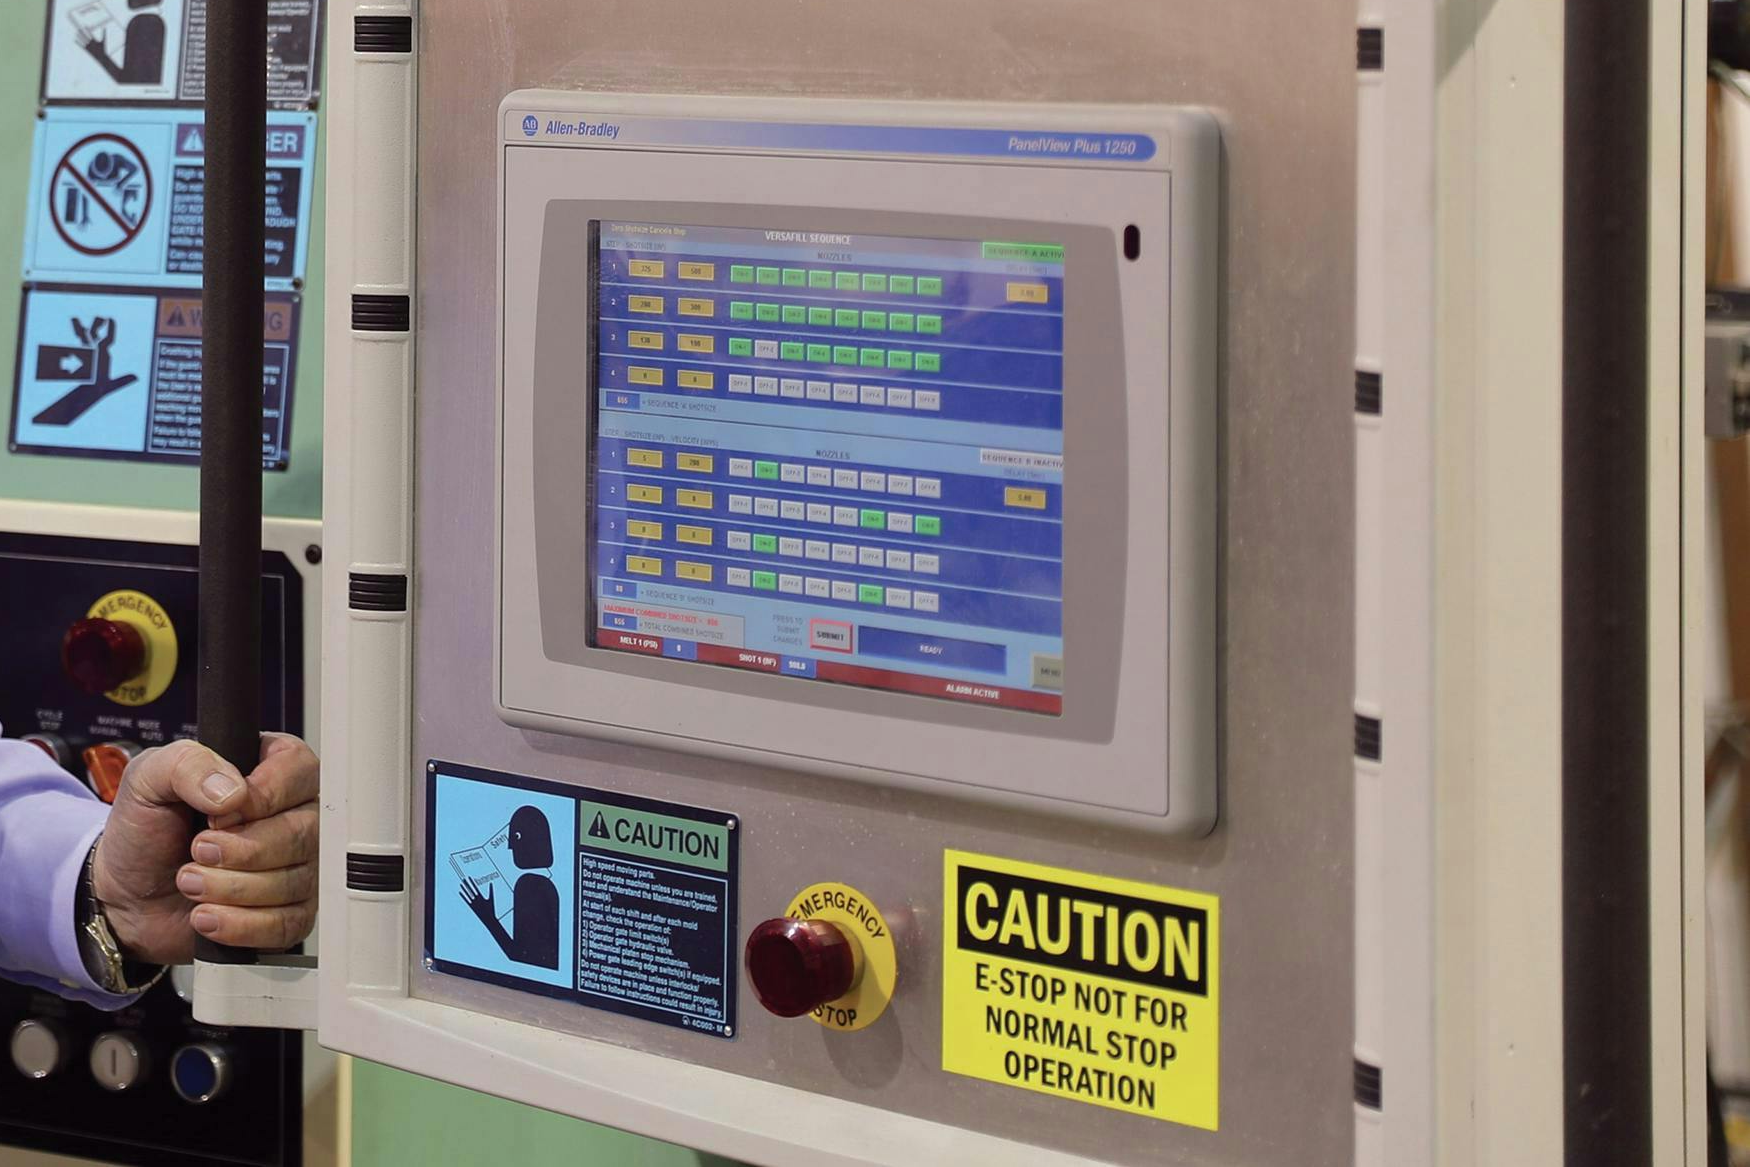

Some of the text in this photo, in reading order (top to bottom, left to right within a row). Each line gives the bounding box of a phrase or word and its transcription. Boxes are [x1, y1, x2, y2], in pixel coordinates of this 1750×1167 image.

[546, 120, 620, 140] Allen-Bradley
[1008, 137, 1137, 155] PanelView Plus 1250
[765, 230, 851, 245] VERSAFILL SEQUENCE
[817, 251, 852, 262] NOZZLES
[815, 449, 851, 460] NOZZLES
[93, 595, 168, 630] MERGENCY
[619, 635, 637, 646] MELT
[816, 630, 844, 642] SUBMIT
[738, 652, 756, 663] SHOT
[919, 644, 943, 656] READY
[946, 683, 1000, 700] ALARM ACTIVE
[614, 817, 720, 860] CAUTION
[583, 857, 596, 869] High
[597, 860, 614, 873] speed
[616, 864, 637, 877] moving
[583, 878, 595, 888] read
[596, 881, 607, 891] and
[608, 883, 641, 897] understand
[642, 890, 651, 899] the
[592, 871, 601, 880] not
[602, 873, 624, 886] operate
[625, 877, 649, 889] machine
[651, 882, 670, 893] unless
[671, 887, 682, 898] you
[684, 890, 693, 898] are
[590, 900, 603, 911] start
[611, 905, 625, 915] each
[626, 908, 639, 918] shift
[640, 911, 651, 921] and
[652, 913, 666, 924] after
[667, 916, 681, 927] each
[682, 919, 698, 930] mold
[606, 913, 623, 924] check
[624, 917, 633, 927] the
[634, 919, 661, 934] operation
[589, 920, 613, 935] Operator
[615, 926, 627, 938] gate
[629, 929, 641, 939] limit
[964, 881, 1200, 983] CAUTION
[589, 930, 613, 945] Operator
[614, 936, 627, 948] gate
[628, 938, 655, 953] hydraulic
[589, 940, 620, 954] Mechanical
[622, 947, 639, 960] platen
[640, 951, 653, 963] stop
[589, 949, 606, 960] Power
[607, 953, 620, 965] gate
[621, 956, 642, 970] leading
[643, 961, 657, 973] edge
[590, 961, 599, 970] not
[600, 963, 621, 977] operate
[623, 968, 647, 981] machine
[648, 973, 667, 985] unless
[580, 978, 599, 990] Failure
[608, 984, 625, 995] follow
[626, 988, 660, 1003] instructions
[661, 996, 678, 1007] could
[679, 1000, 696, 1011] result
[581, 969, 597, 982] safety
[599, 973, 620, 985] devices
[622, 979, 631, 987] are
[639, 981, 654, 994] place
[655, 985, 666, 995] and
[668, 988, 691, 1000] function
[975, 962, 1188, 1033] E-STOP NOT FOR
[986, 1004, 1178, 1071] NORMAL STOP
[1004, 1050, 1156, 1111] OPERATION
